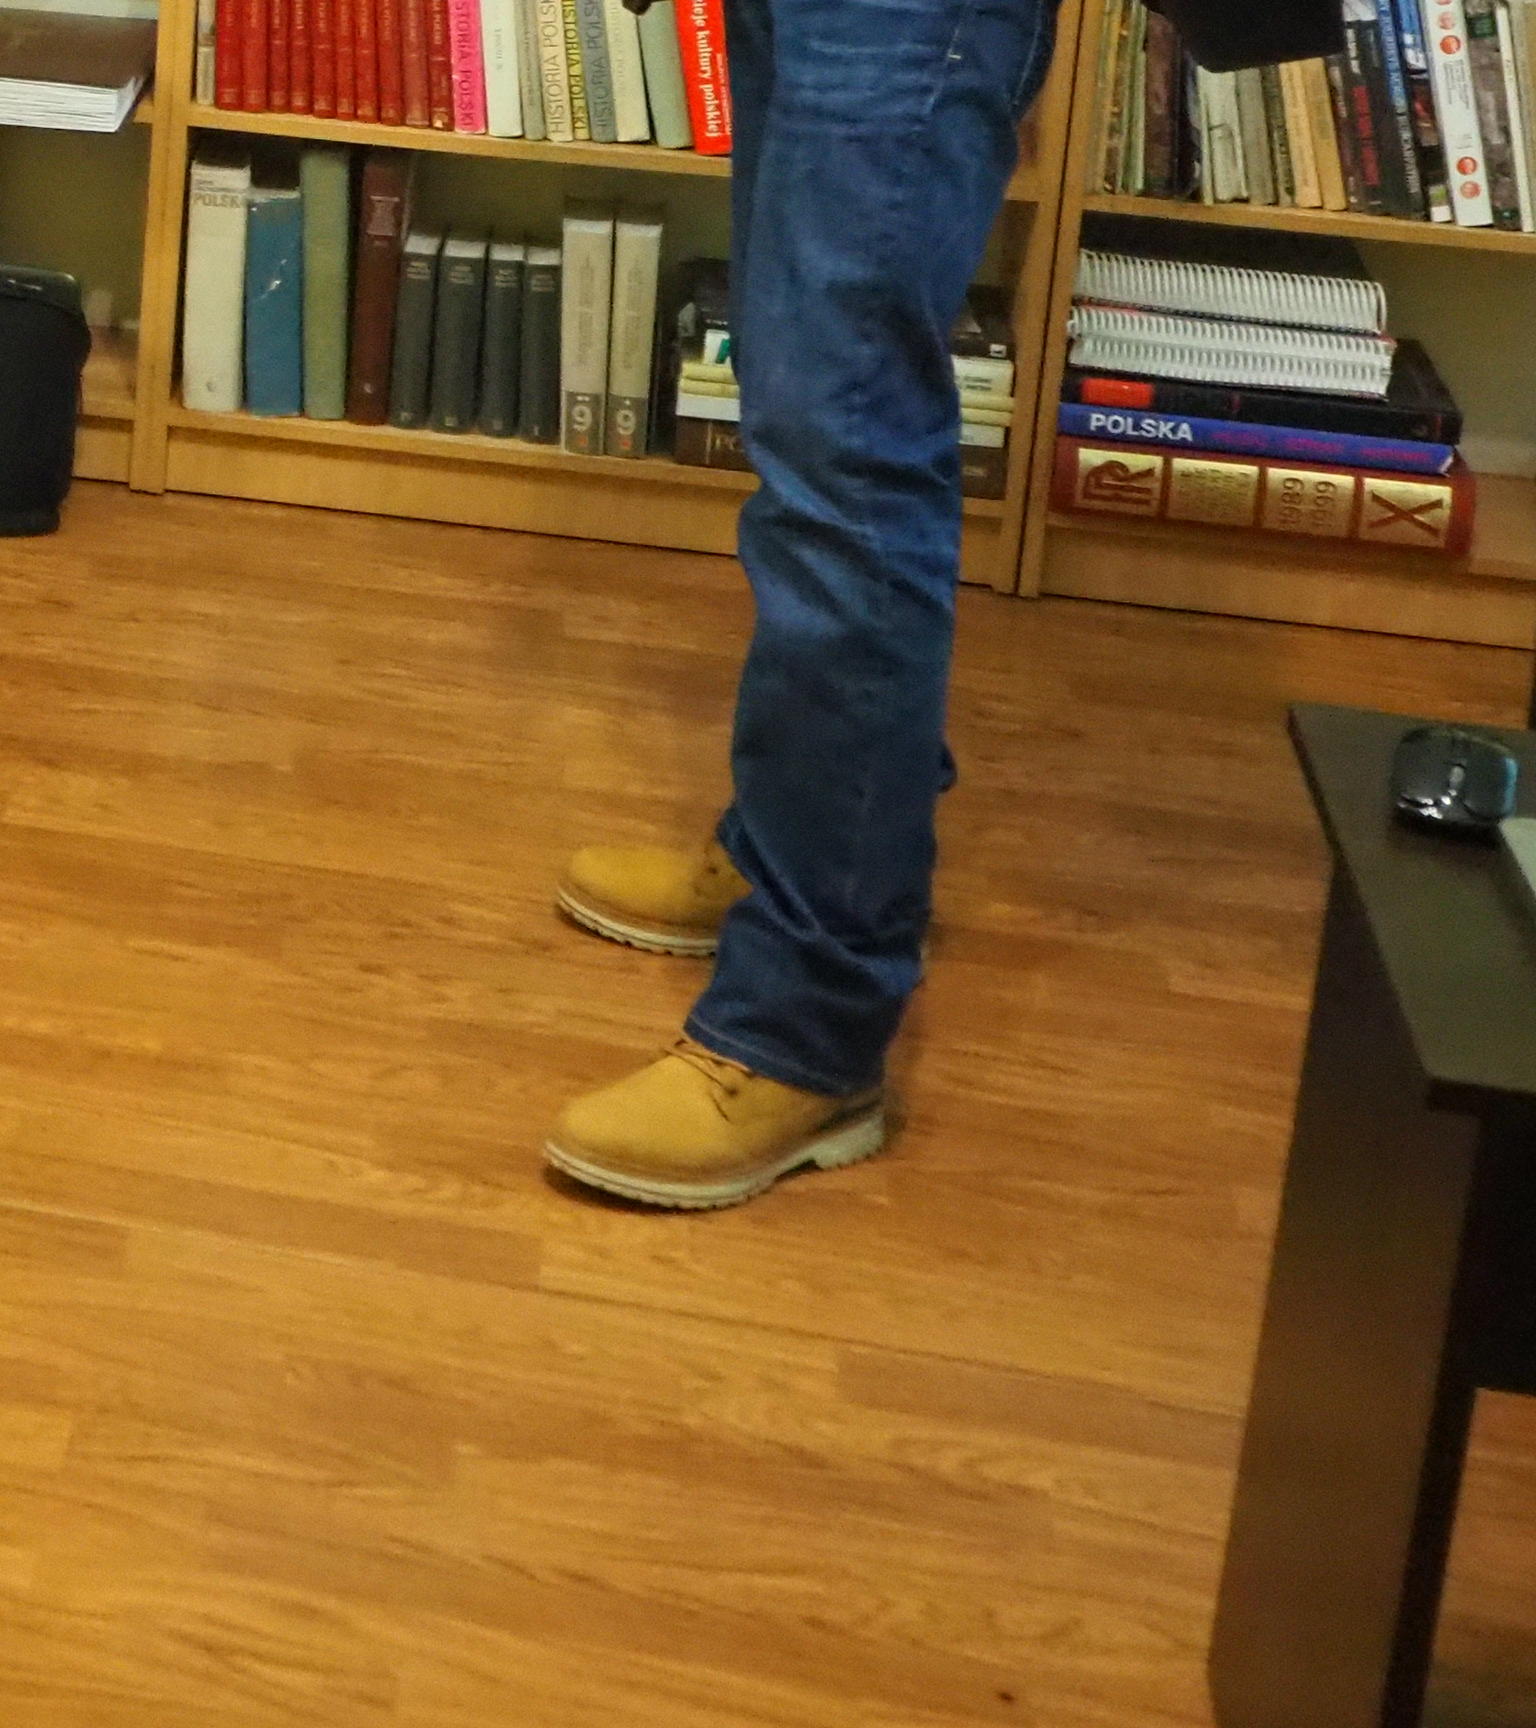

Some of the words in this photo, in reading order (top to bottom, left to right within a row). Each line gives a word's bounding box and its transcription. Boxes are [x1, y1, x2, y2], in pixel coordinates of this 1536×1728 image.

[695, 30, 716, 80] kultury
[458, 69, 477, 129] POLSKI
[546, 55, 565, 134] HISTORIA
[569, 74, 587, 130] POLSKI
[591, 56, 612, 130] HISTORIA
[699, 83, 721, 138] polskiej
[1090, 412, 1193, 443] POLSKA
[1278, 477, 1304, 527] 1989
